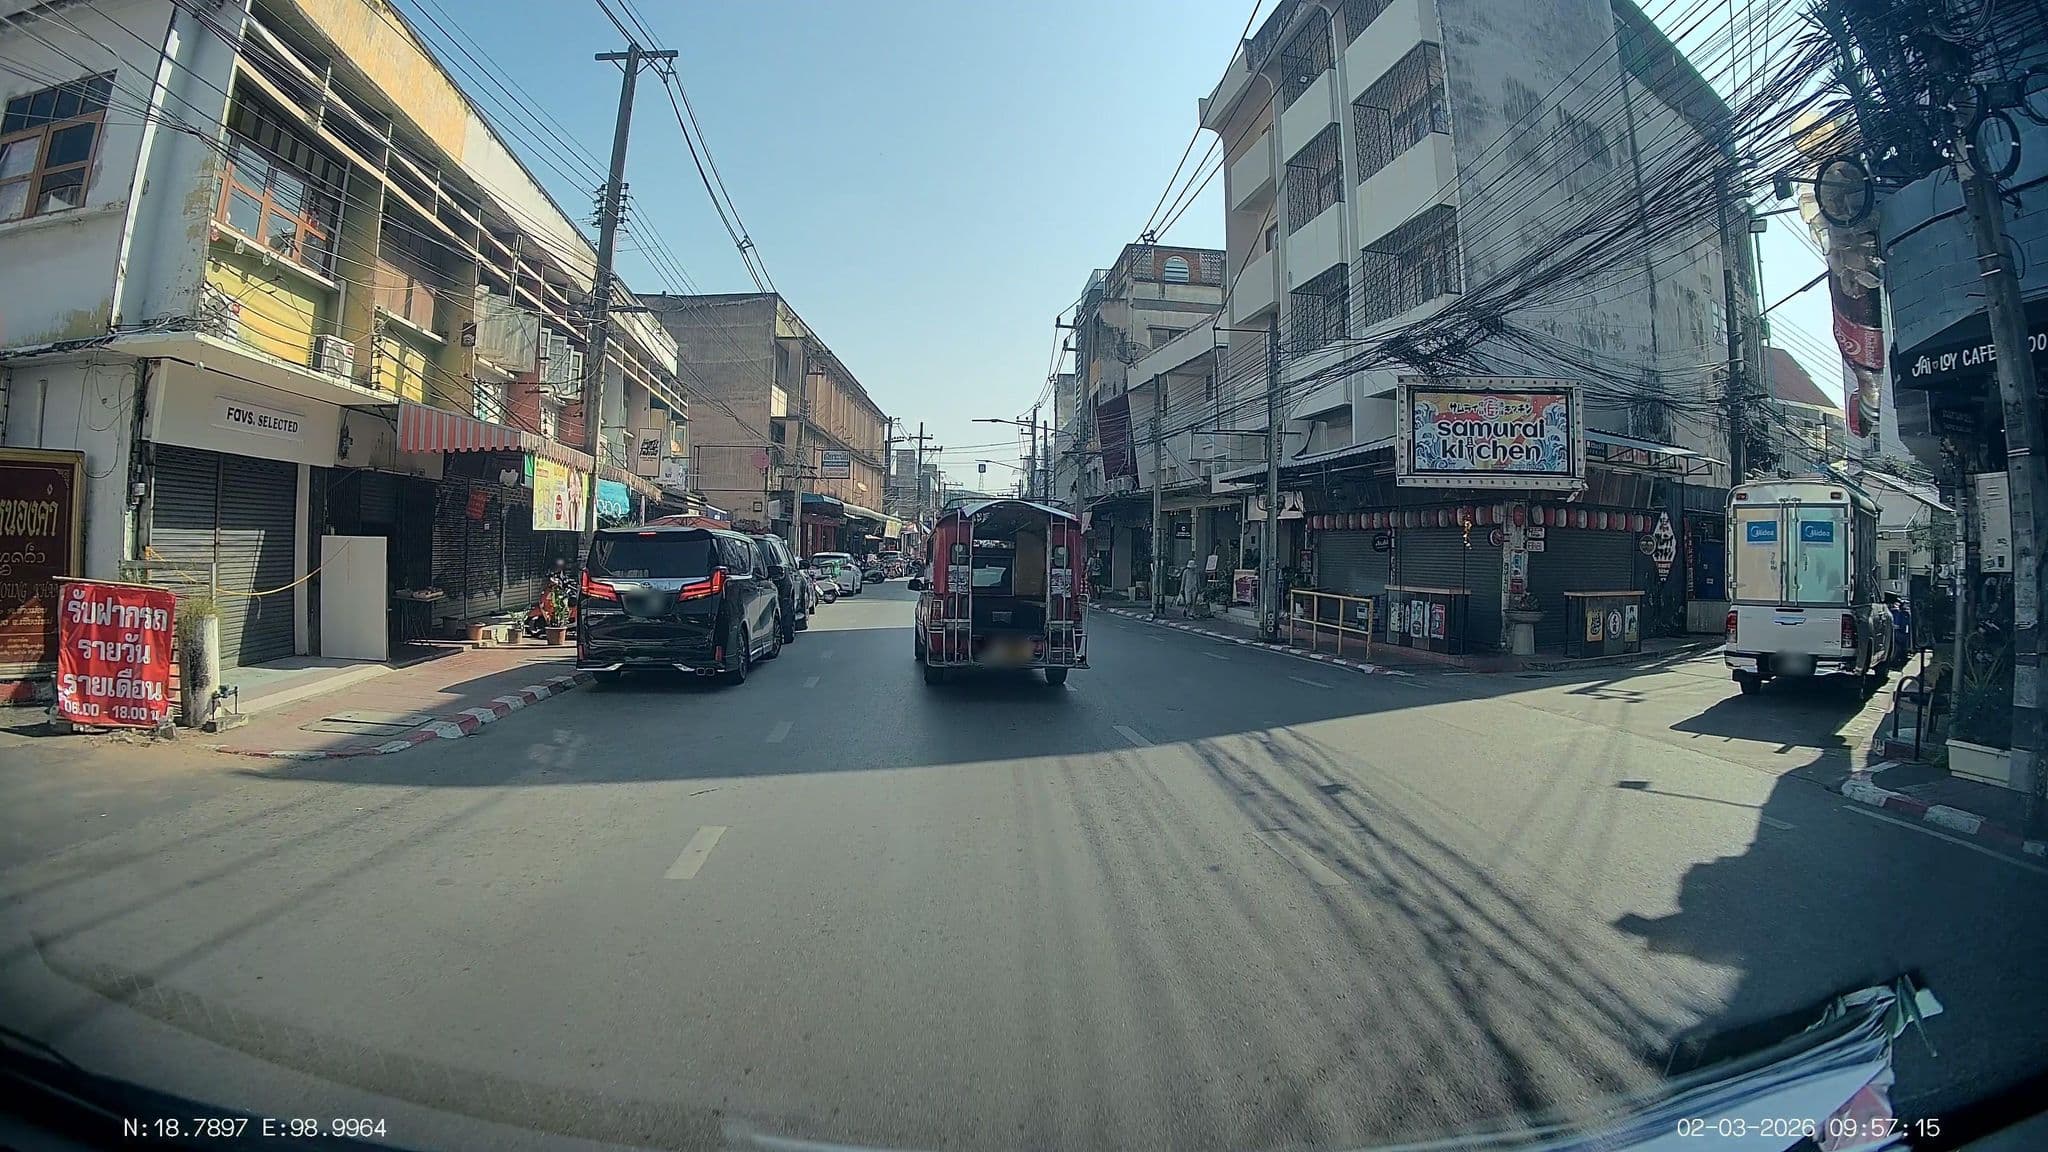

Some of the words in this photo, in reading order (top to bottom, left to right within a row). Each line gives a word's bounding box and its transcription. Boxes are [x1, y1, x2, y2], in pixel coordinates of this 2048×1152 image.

[1940, 353, 1957, 371] LOY
[1962, 344, 1997, 366] CAFE
[258, 414, 298, 433] SELECTED
[1438, 419, 1545, 440] samurai
[1441, 438, 1541, 464] kitchen
[0, 484, 58, 536] นองคำ
[1752, 526, 1774, 537] Midea
[1806, 526, 1830, 537] Midea
[67, 588, 168, 632] รับฝากรถ
[78, 633, 151, 664] รายวัน
[63, 668, 163, 701] รายเดือน
[112, 705, 147, 720] 18.00
